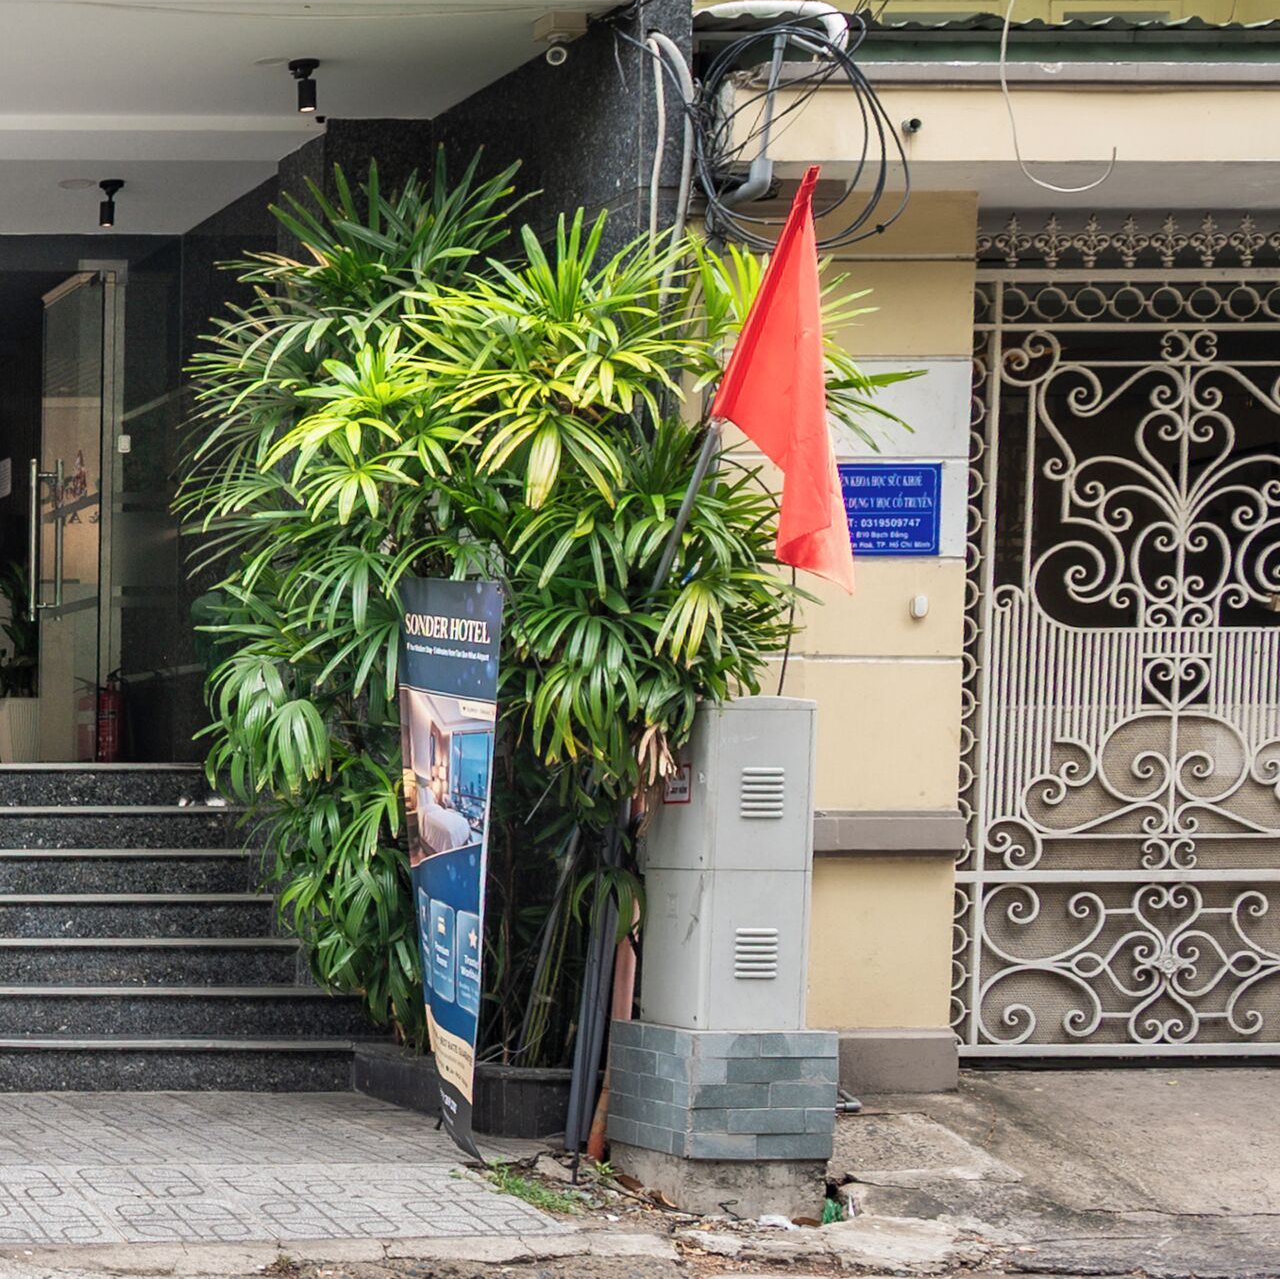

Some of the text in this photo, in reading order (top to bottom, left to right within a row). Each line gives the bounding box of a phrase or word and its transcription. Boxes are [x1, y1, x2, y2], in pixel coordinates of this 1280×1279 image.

[860, 518, 921, 528] 0319509747
[405, 612, 491, 644] SONDER HOTEL
